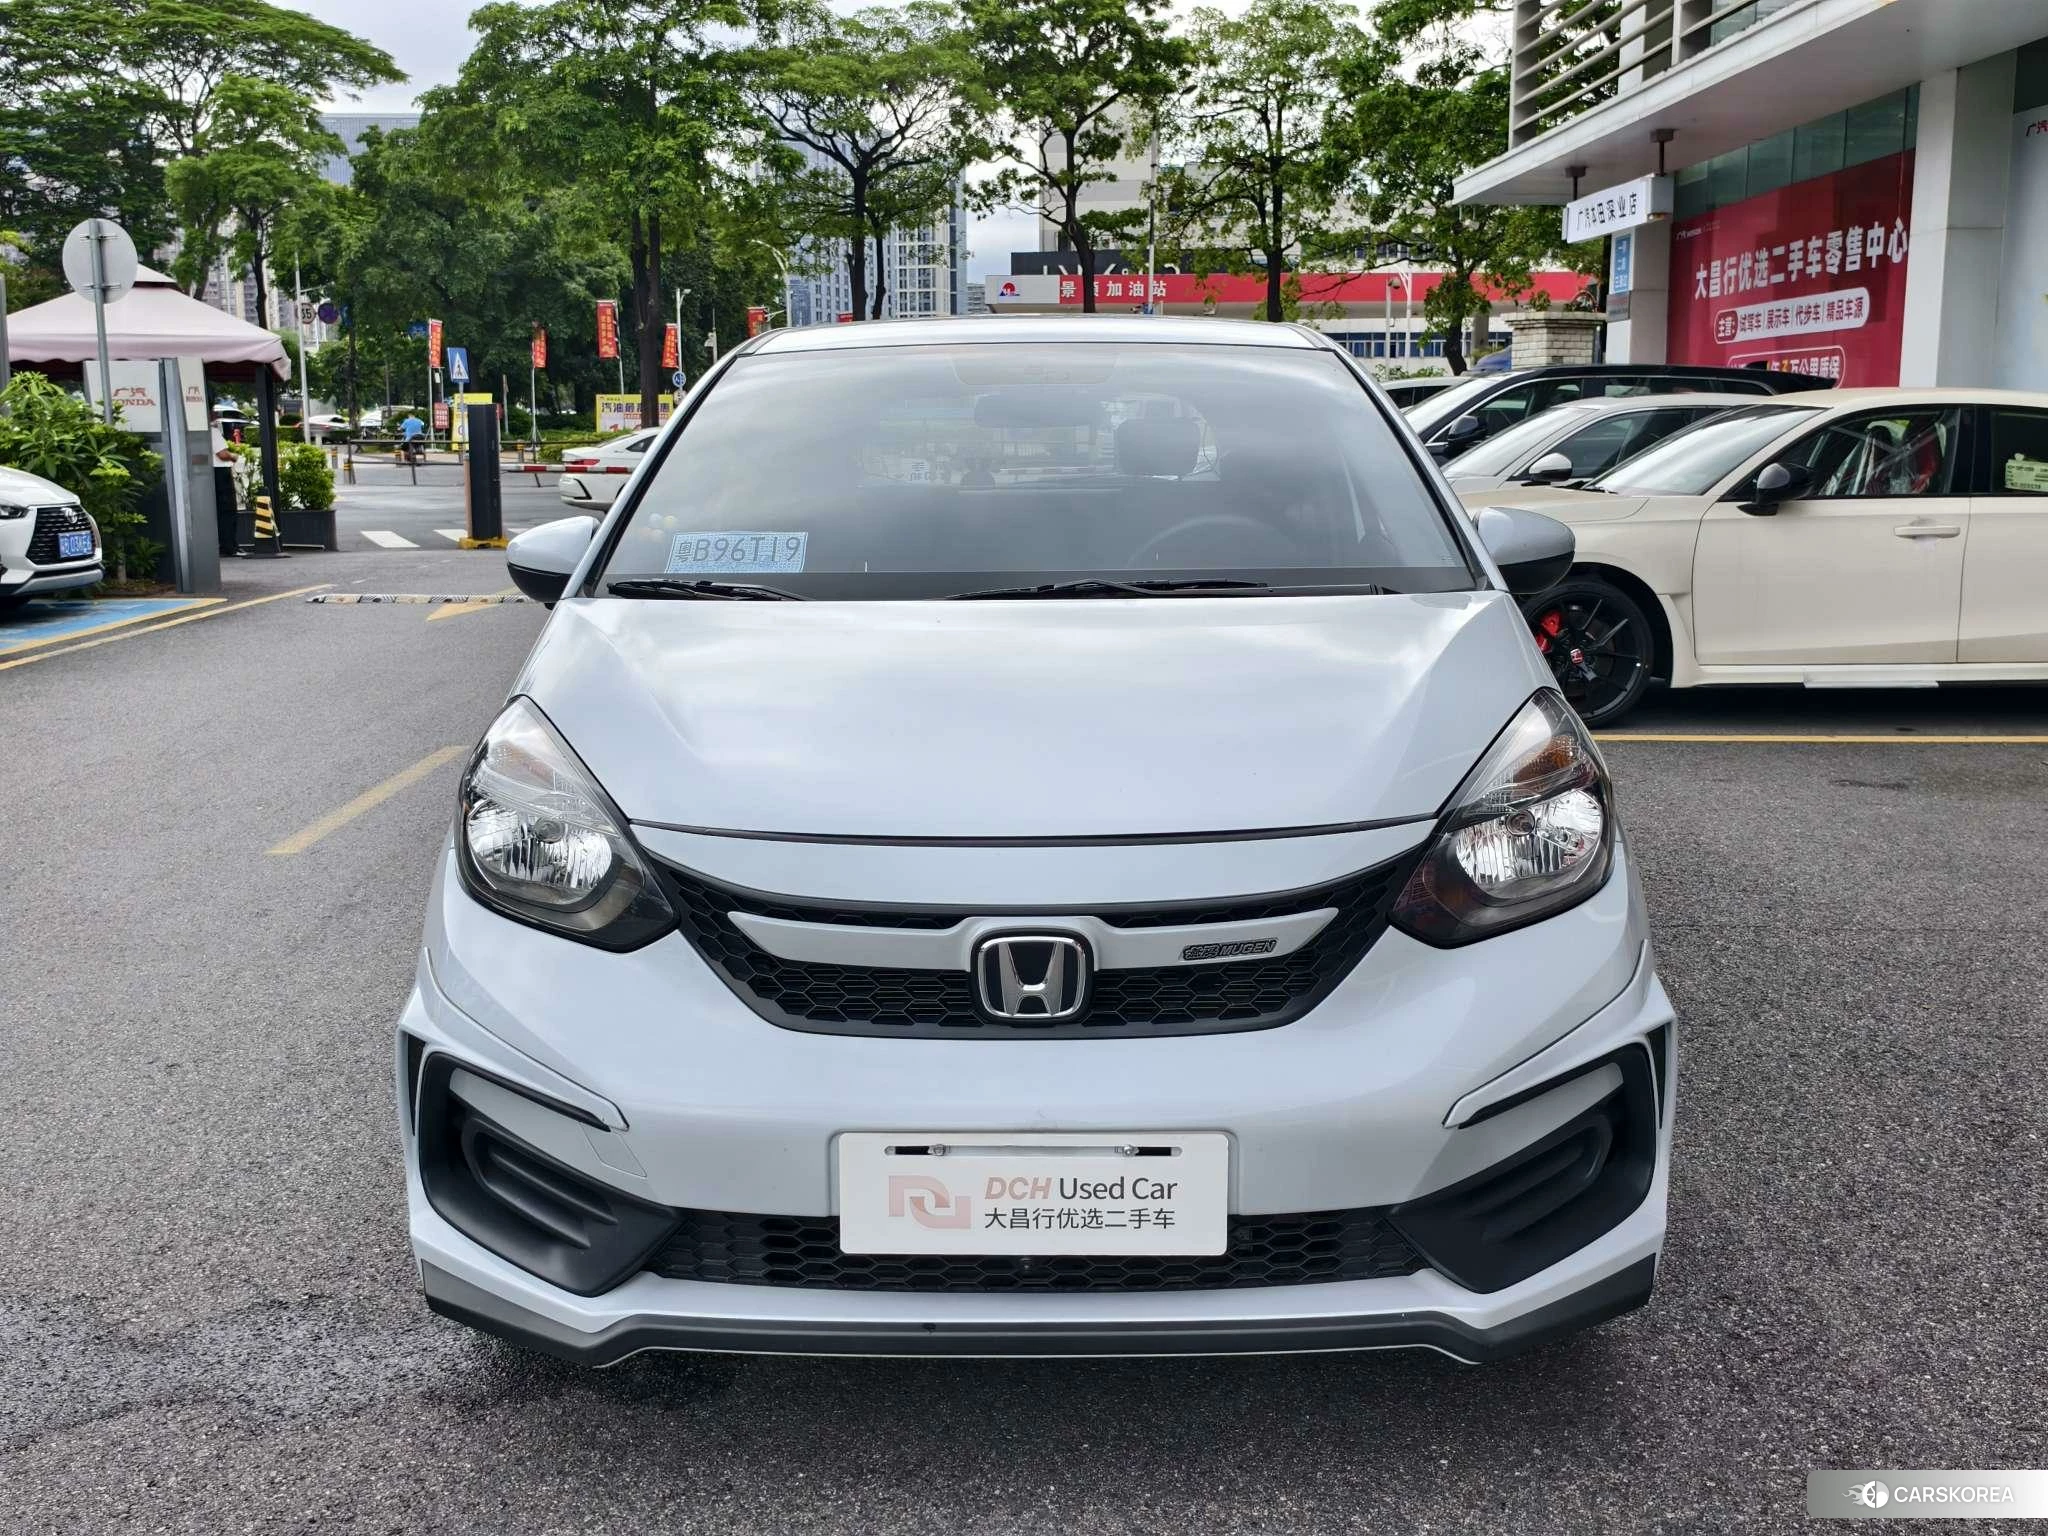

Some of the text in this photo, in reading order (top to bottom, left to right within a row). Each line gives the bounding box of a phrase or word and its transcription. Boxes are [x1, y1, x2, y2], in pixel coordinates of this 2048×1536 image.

[1695, 216, 1908, 300] 大昌行优选二手车零售中心
[1767, 306, 1791, 329] 展示车
[1795, 301, 1822, 327] 代步车
[1826, 296, 1864, 322] 精品车源
[1219, 940, 1277, 955] MUGEN
[984, 1176, 1178, 1200] DCH Used Car
[984, 1207, 1176, 1230] 大昌行优选二手车
